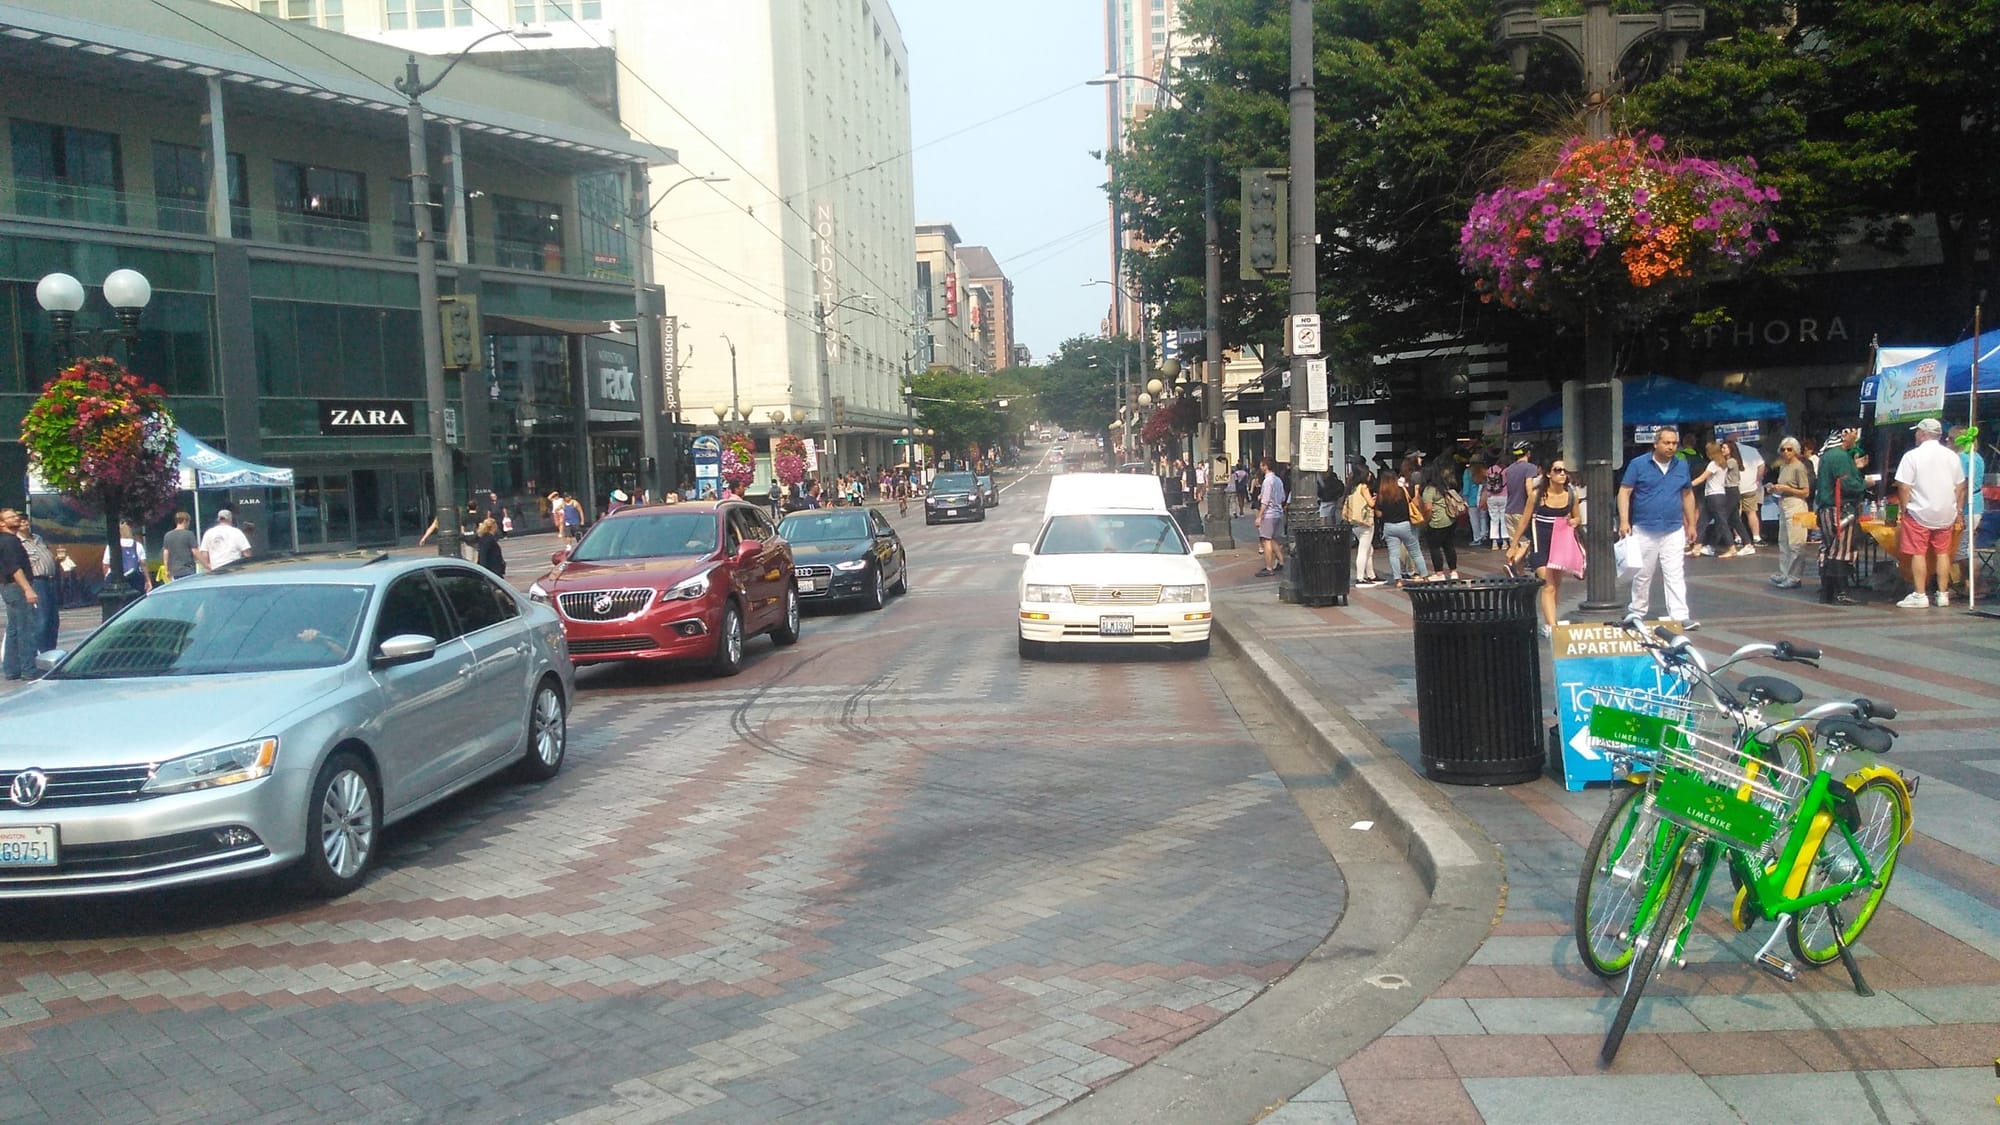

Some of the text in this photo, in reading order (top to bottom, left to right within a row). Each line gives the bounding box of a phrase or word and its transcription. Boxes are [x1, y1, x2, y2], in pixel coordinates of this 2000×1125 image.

[817, 204, 838, 359] NORDSTROM
[915, 293, 928, 374] NORDSTR
[1656, 315, 1849, 350] SPHORA
[664, 318, 677, 409] NORDSTROM rack
[600, 365, 636, 401] rack
[1903, 386, 1939, 400] BRACELET
[1907, 374, 1937, 388] LIBERTY
[331, 409, 408, 425] ZARA
[1569, 626, 1623, 641] WATER
[1614, 732, 1650, 745] LIMEBIKE
[1686, 806, 1732, 832] LIMEBIKE
